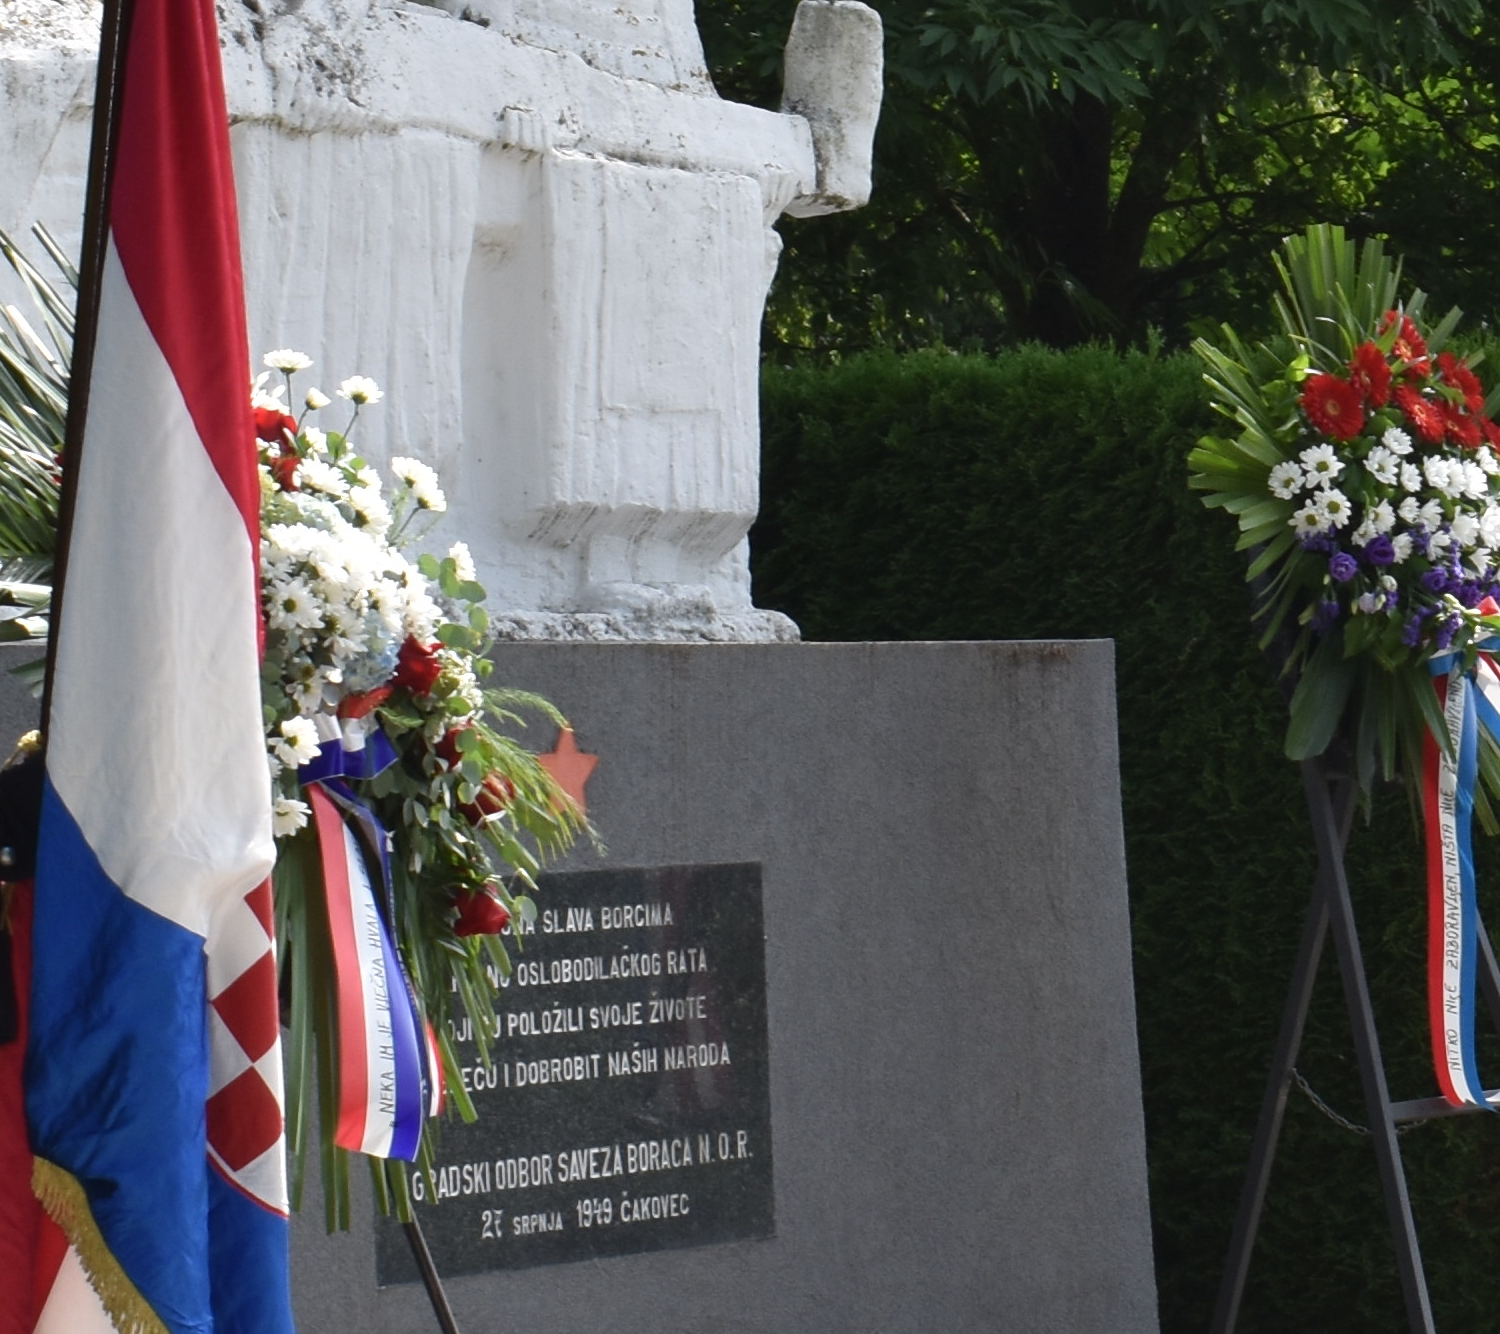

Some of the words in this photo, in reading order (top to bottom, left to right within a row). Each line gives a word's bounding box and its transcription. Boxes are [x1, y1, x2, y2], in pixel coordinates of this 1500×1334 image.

[542, 907, 594, 933] SLAVA
[601, 902, 674, 930] BORCIMA
[517, 945, 662, 986] OSLOBODILAČKOG
[667, 947, 708, 975] RATA
[508, 1001, 583, 1036] POLOŽILI
[589, 1002, 643, 1030] SVOJE
[649, 991, 707, 1024] ŽIVOTE
[504, 1063, 509, 1088] I
[516, 1054, 600, 1087] DOBROBIT
[608, 1041, 658, 1077] NAŠIH
[664, 1041, 731, 1070] NARODA
[495, 1154, 553, 1190] ODBOR
[557, 1145, 623, 1182] SAVEZA
[627, 1137, 693, 1174] BORACA
[513, 1212, 564, 1236] SRPNJA
[620, 1190, 690, 1222] ČAKOVEC
